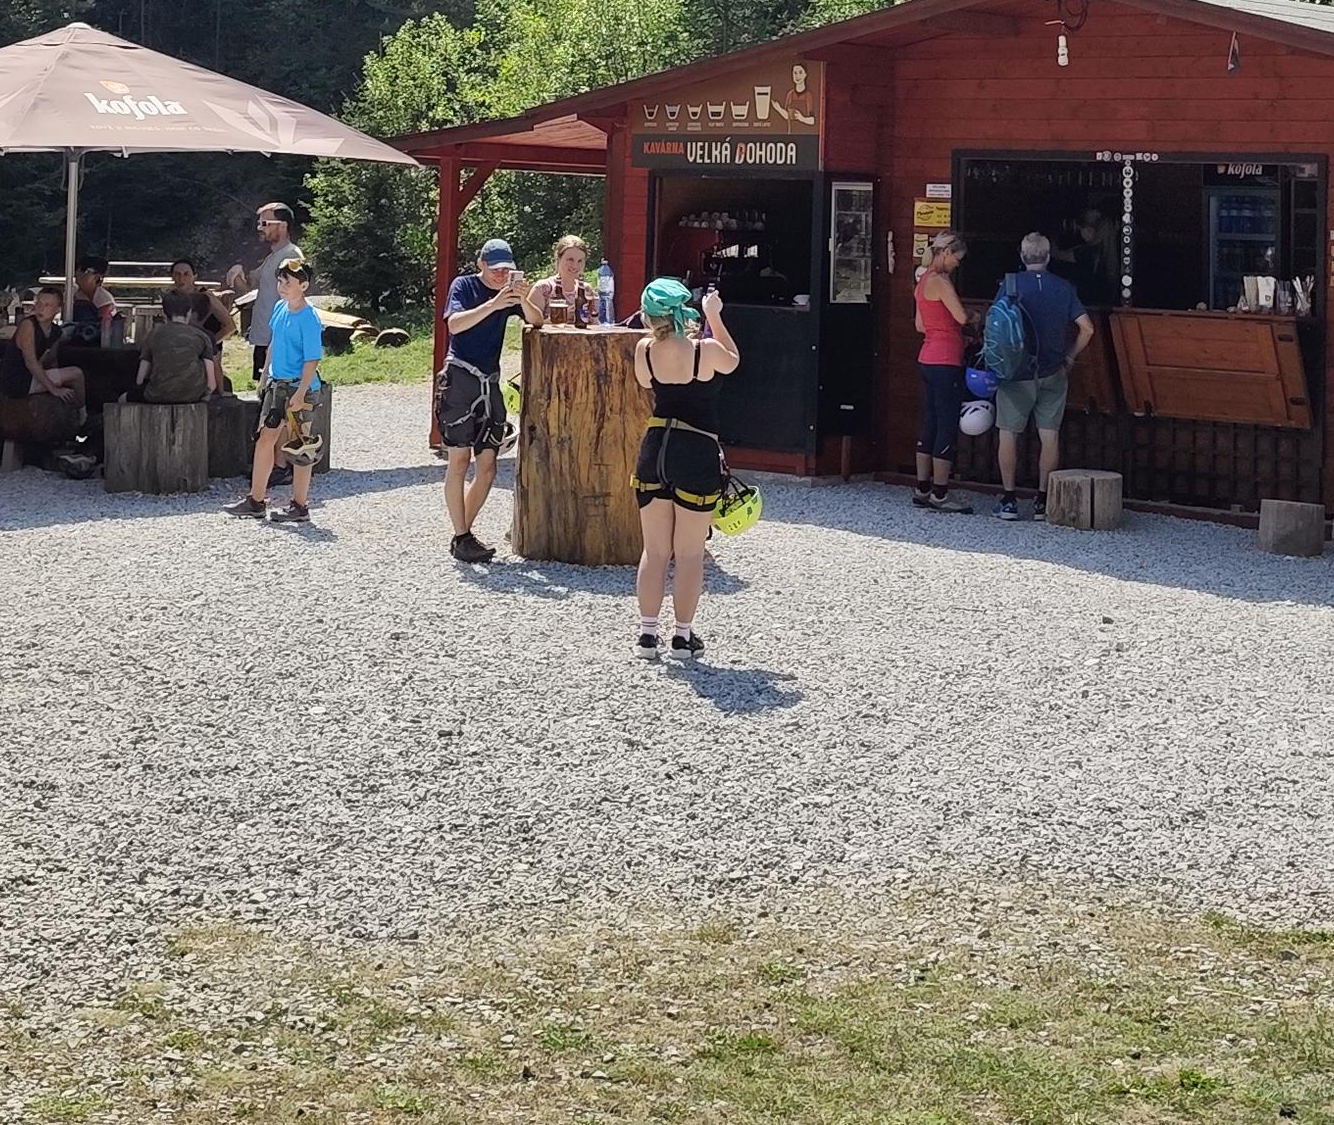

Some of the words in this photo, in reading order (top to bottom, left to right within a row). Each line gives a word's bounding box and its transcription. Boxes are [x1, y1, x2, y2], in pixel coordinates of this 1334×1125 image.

[83, 92, 188, 120] kofola
[643, 139, 685, 155] KAVÁRNA
[687, 136, 731, 164] VELKÁ
[1227, 162, 1263, 179] kofola
